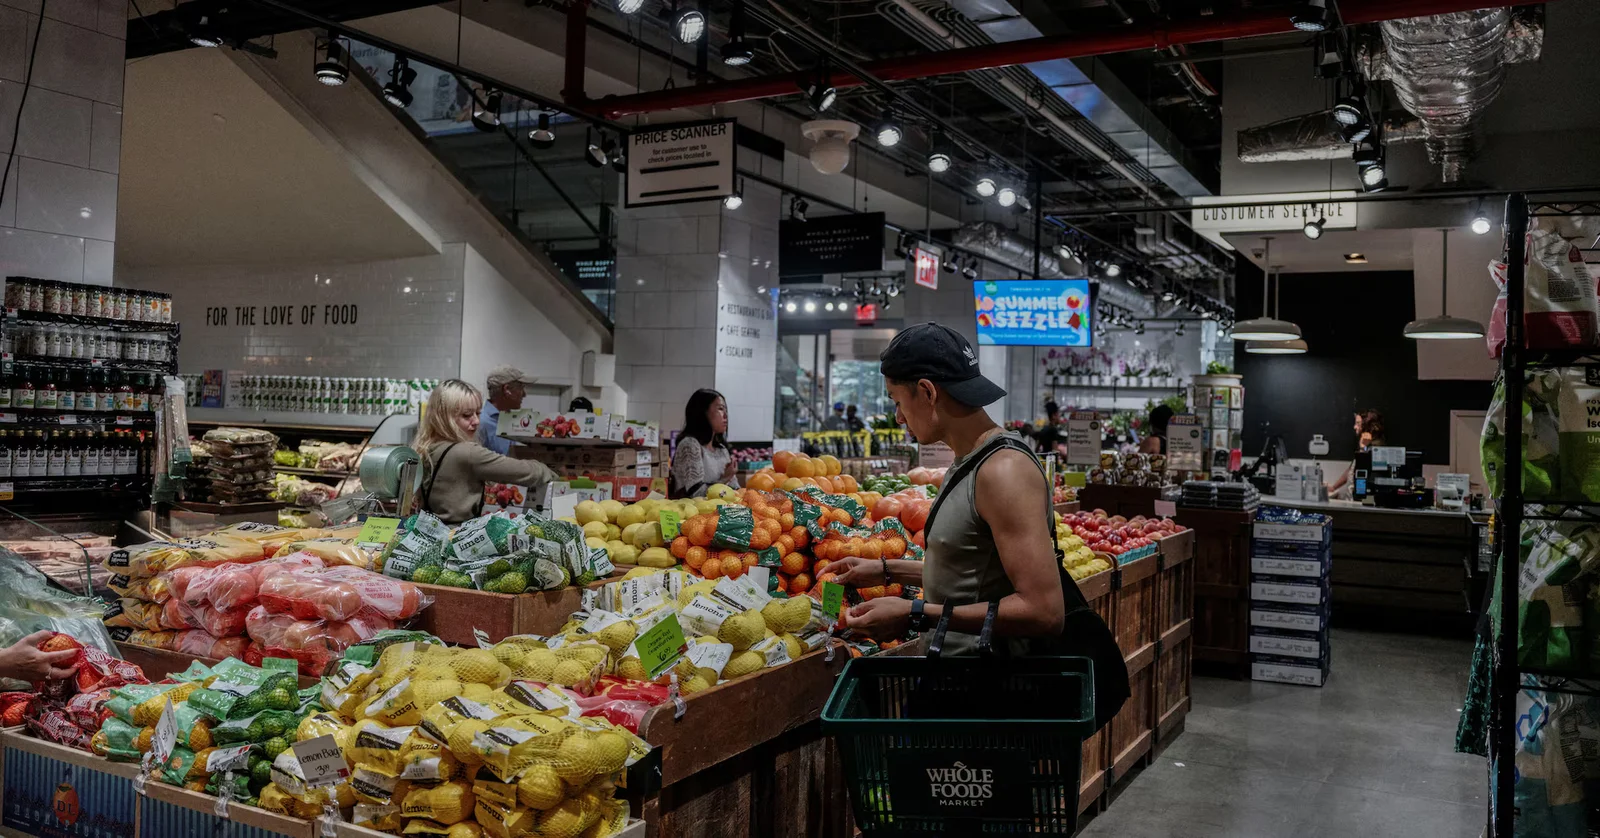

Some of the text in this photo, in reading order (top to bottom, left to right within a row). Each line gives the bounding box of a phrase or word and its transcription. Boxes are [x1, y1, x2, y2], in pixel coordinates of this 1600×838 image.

[635, 123, 727, 146] PRICE SCANNER
[661, 146, 688, 154] customer
[665, 155, 682, 163] prices
[683, 152, 705, 160] located
[1203, 202, 1343, 221] CUSTOMER SERVICE
[994, 295, 1066, 311] SUMMER
[206, 304, 358, 326] FOR THE LOVE OF FOOD
[995, 310, 1071, 331] SIZZLE
[725, 346, 753, 358] ESCALATOR
[458, 533, 486, 552] limes
[692, 600, 725, 618] lemons
[321, 746, 343, 759] Bags
[925, 766, 994, 783] WHOLE
[930, 783, 993, 799] FOODS
[404, 802, 433, 813] lemons
[939, 799, 985, 807] MARKET
